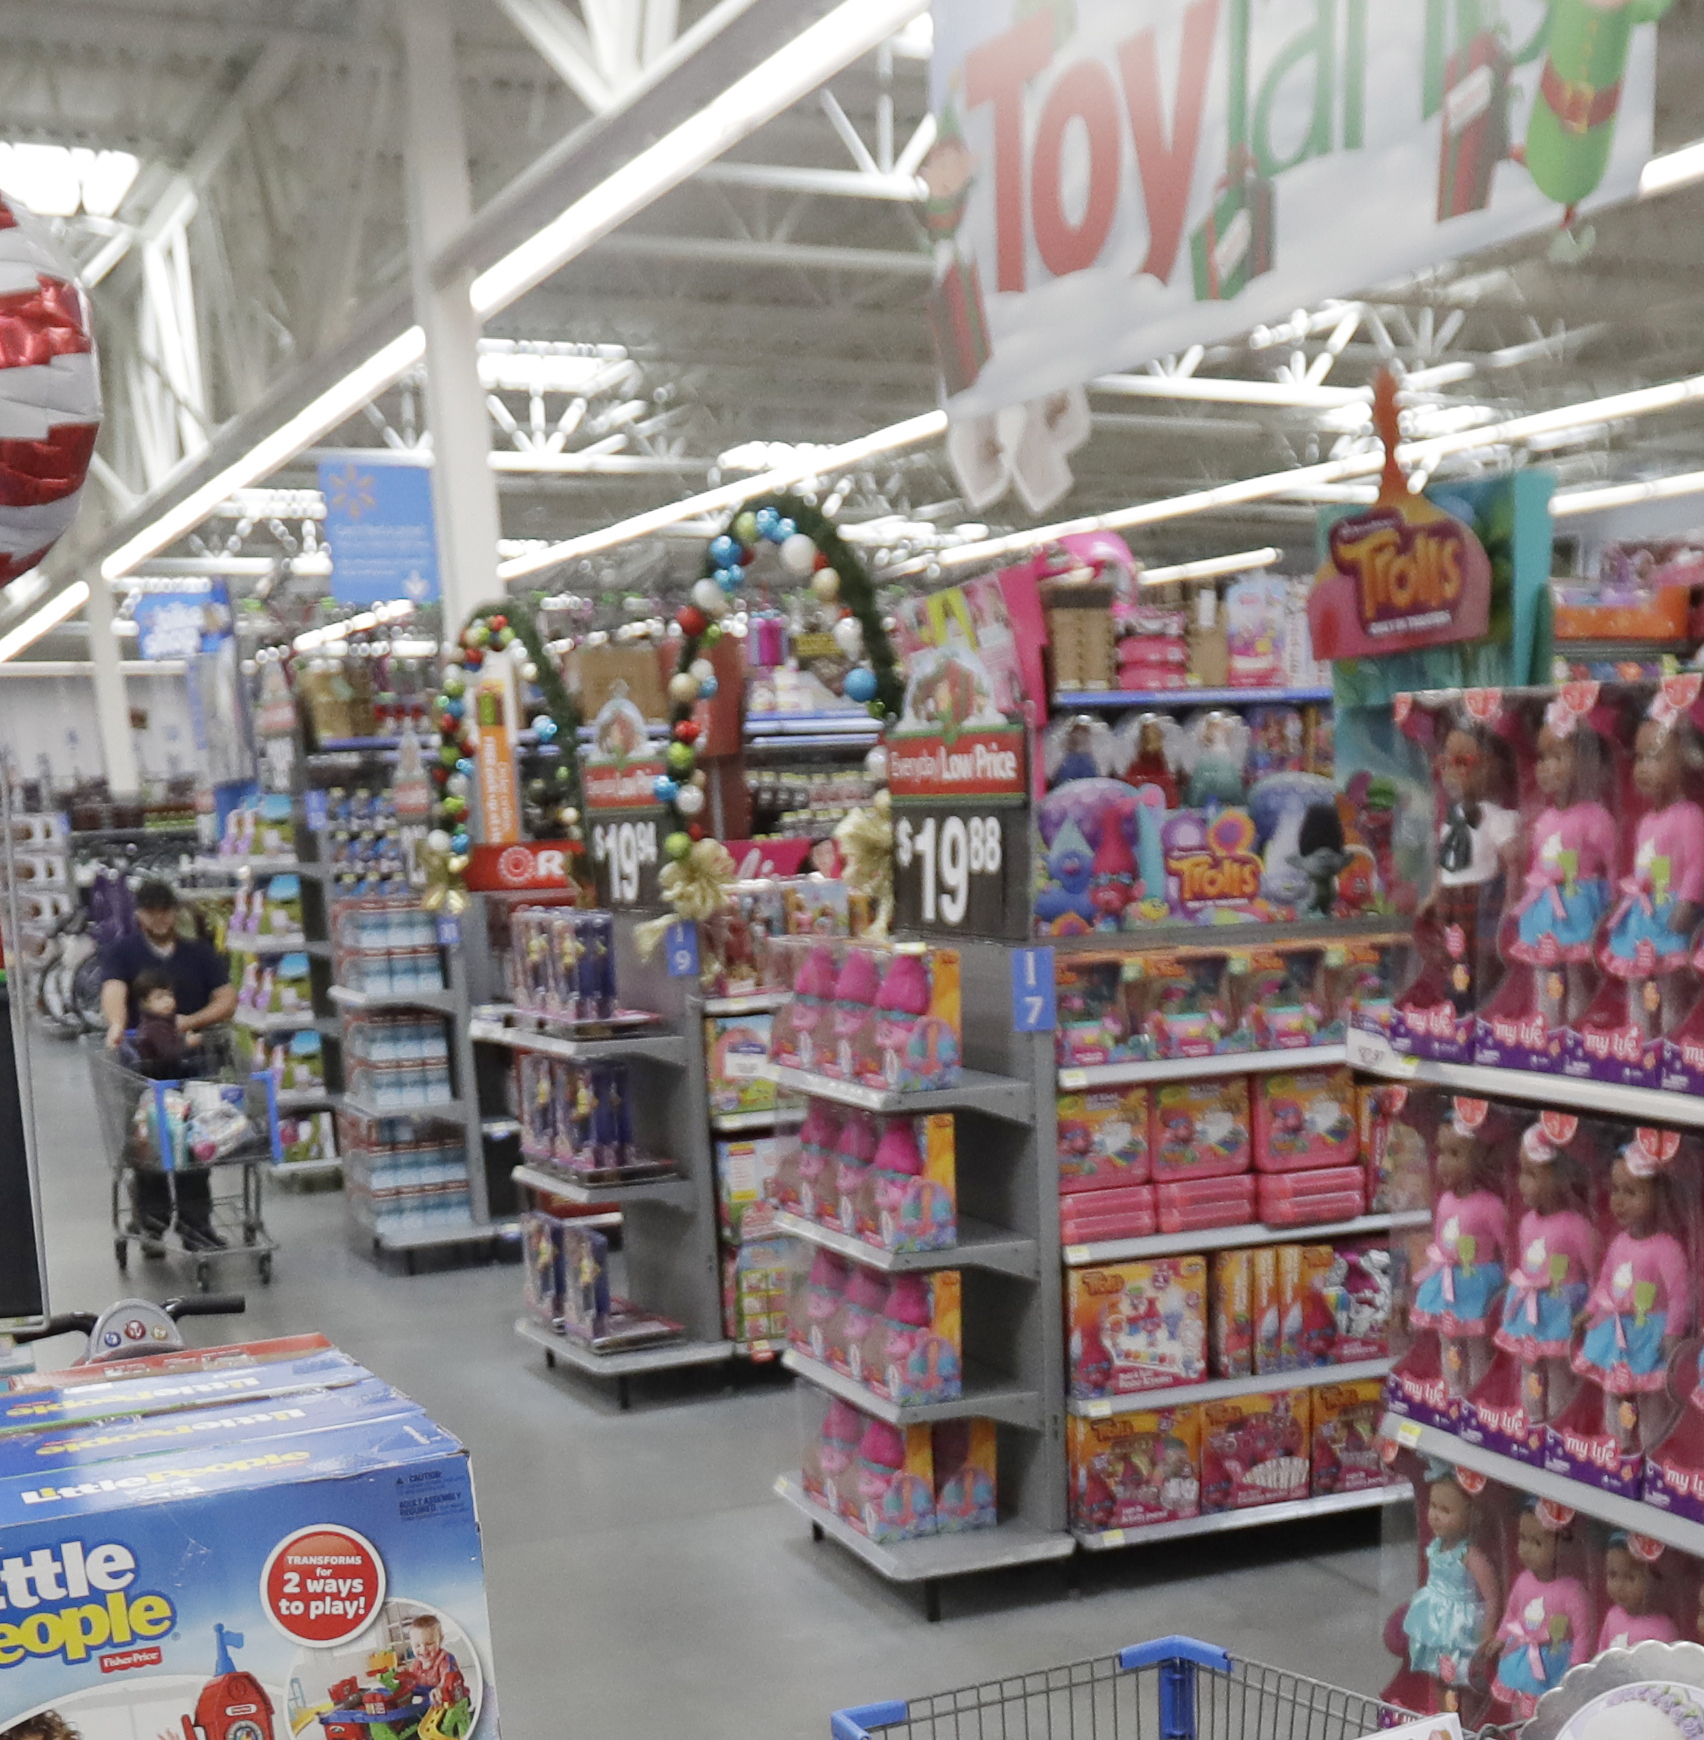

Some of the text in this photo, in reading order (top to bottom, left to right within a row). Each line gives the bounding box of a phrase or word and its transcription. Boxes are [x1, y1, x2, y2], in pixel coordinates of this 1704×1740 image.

[941, 745, 973, 780] Low
[974, 741, 1017, 779] Price
[1025, 999, 1043, 1024] 7
[1566, 1436, 1615, 1464] my life
[1666, 1467, 1690, 1490] my
[285, 1554, 362, 1565] TRANSFORMS
[314, 1566, 333, 1578] for
[282, 1570, 365, 1598] 2 ways
[277, 1595, 366, 1621] to play!
[103, 1650, 158, 1669] Fisher-Price
